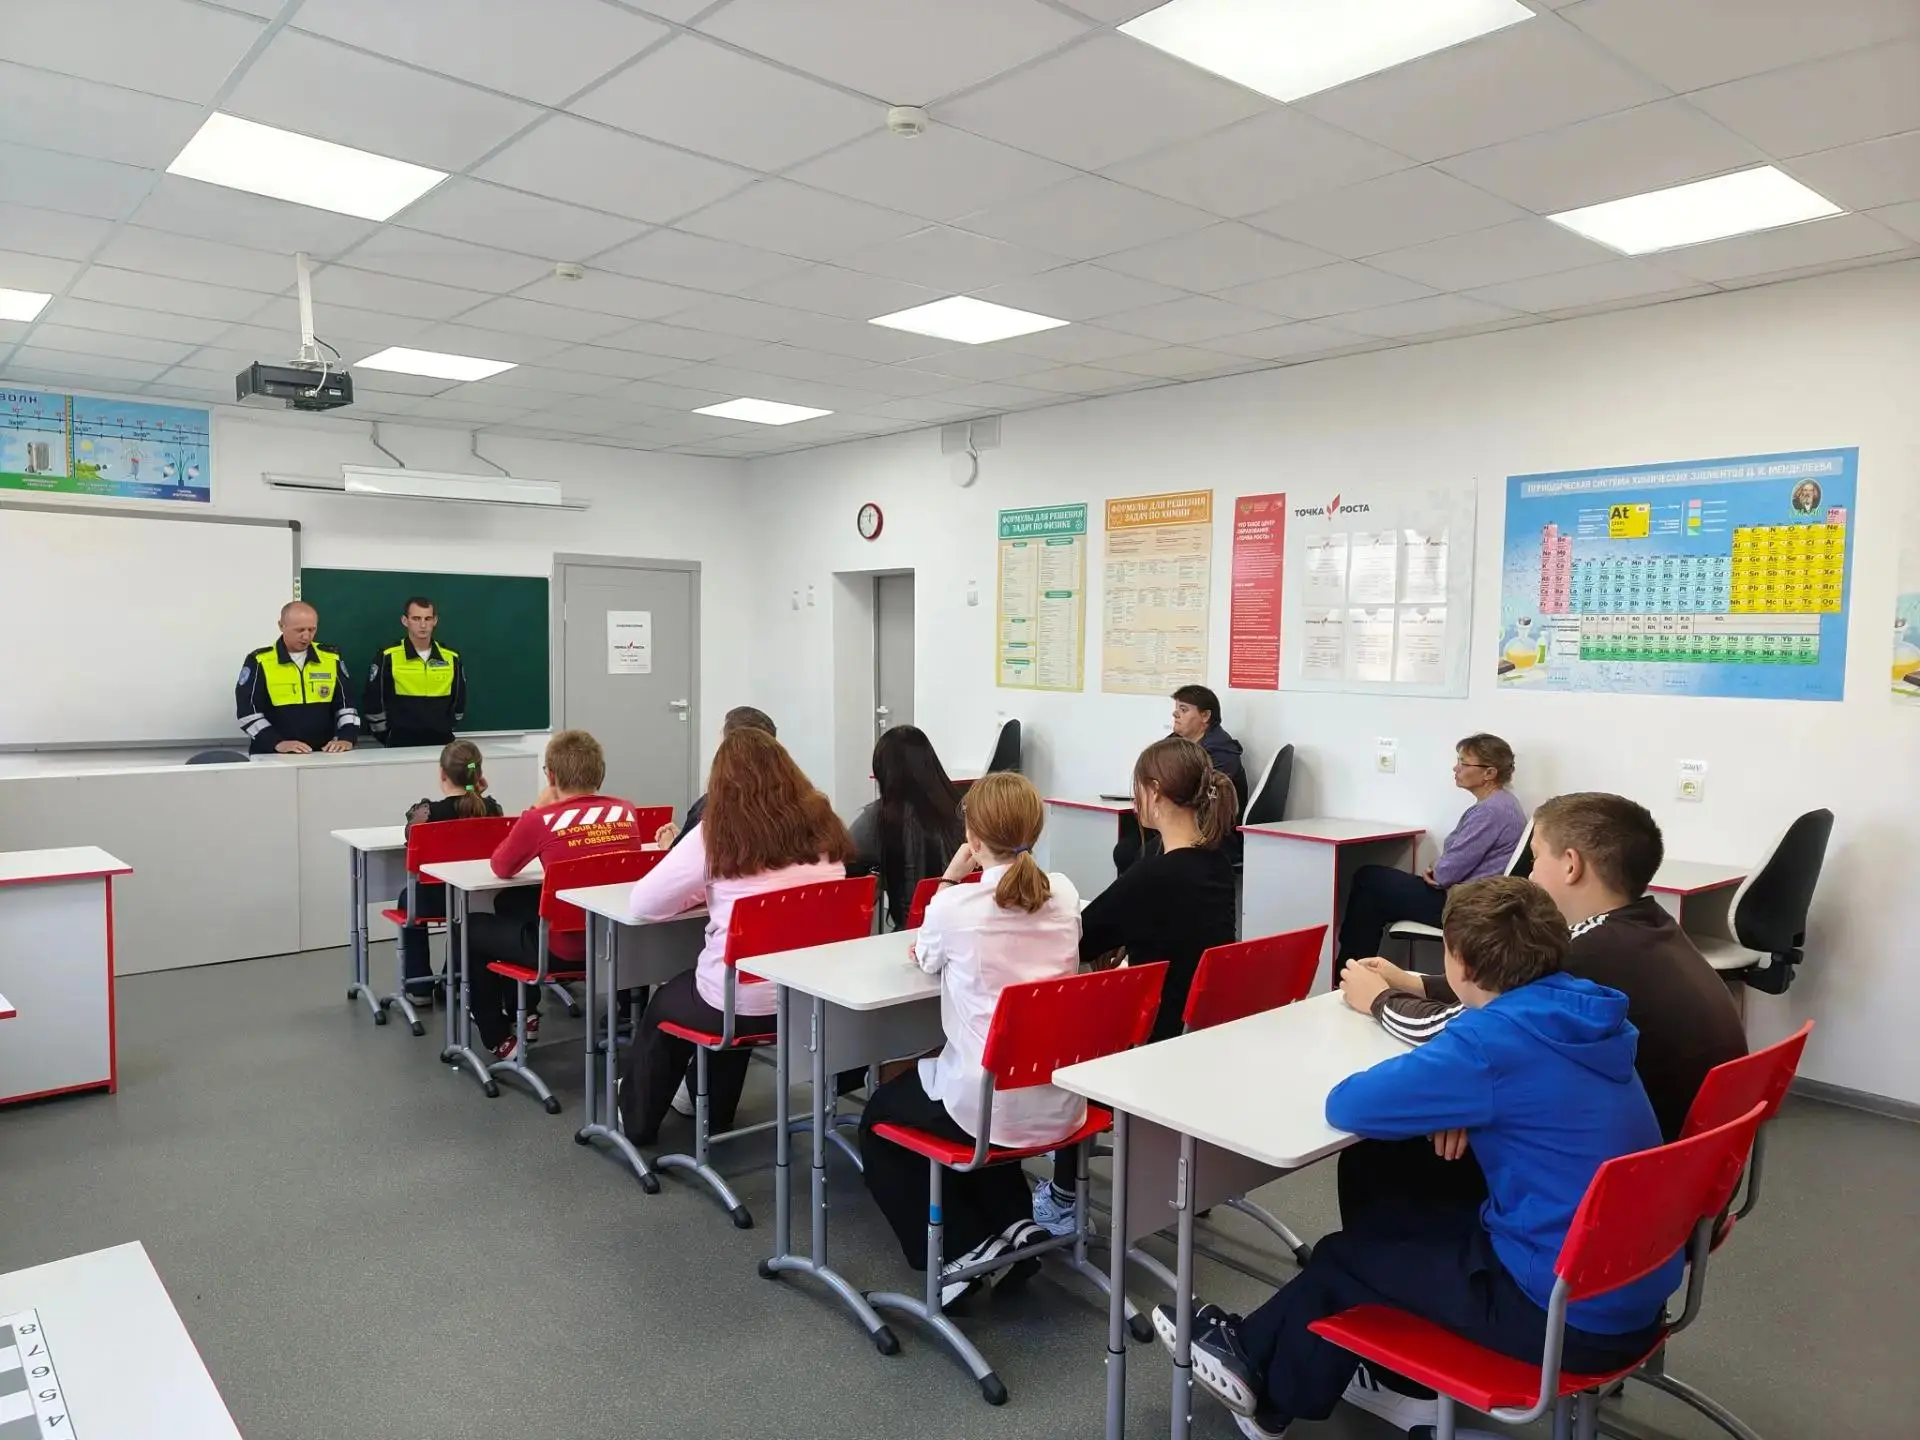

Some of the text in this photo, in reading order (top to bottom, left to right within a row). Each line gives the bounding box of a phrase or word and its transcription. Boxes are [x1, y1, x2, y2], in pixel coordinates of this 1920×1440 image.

[1295, 504, 1370, 517] ТОЧКА РОСТА
[1611, 507, 1630, 519] At
[567, 825, 591, 834] YOUR
[593, 822, 612, 830] PALE
[587, 829, 612, 837] IRONY
[568, 834, 630, 848] MY OBSESSION
[19, 1324, 36, 1335] 8
[39, 1389, 57, 1403] 5
[45, 1414, 65, 1428] 4
